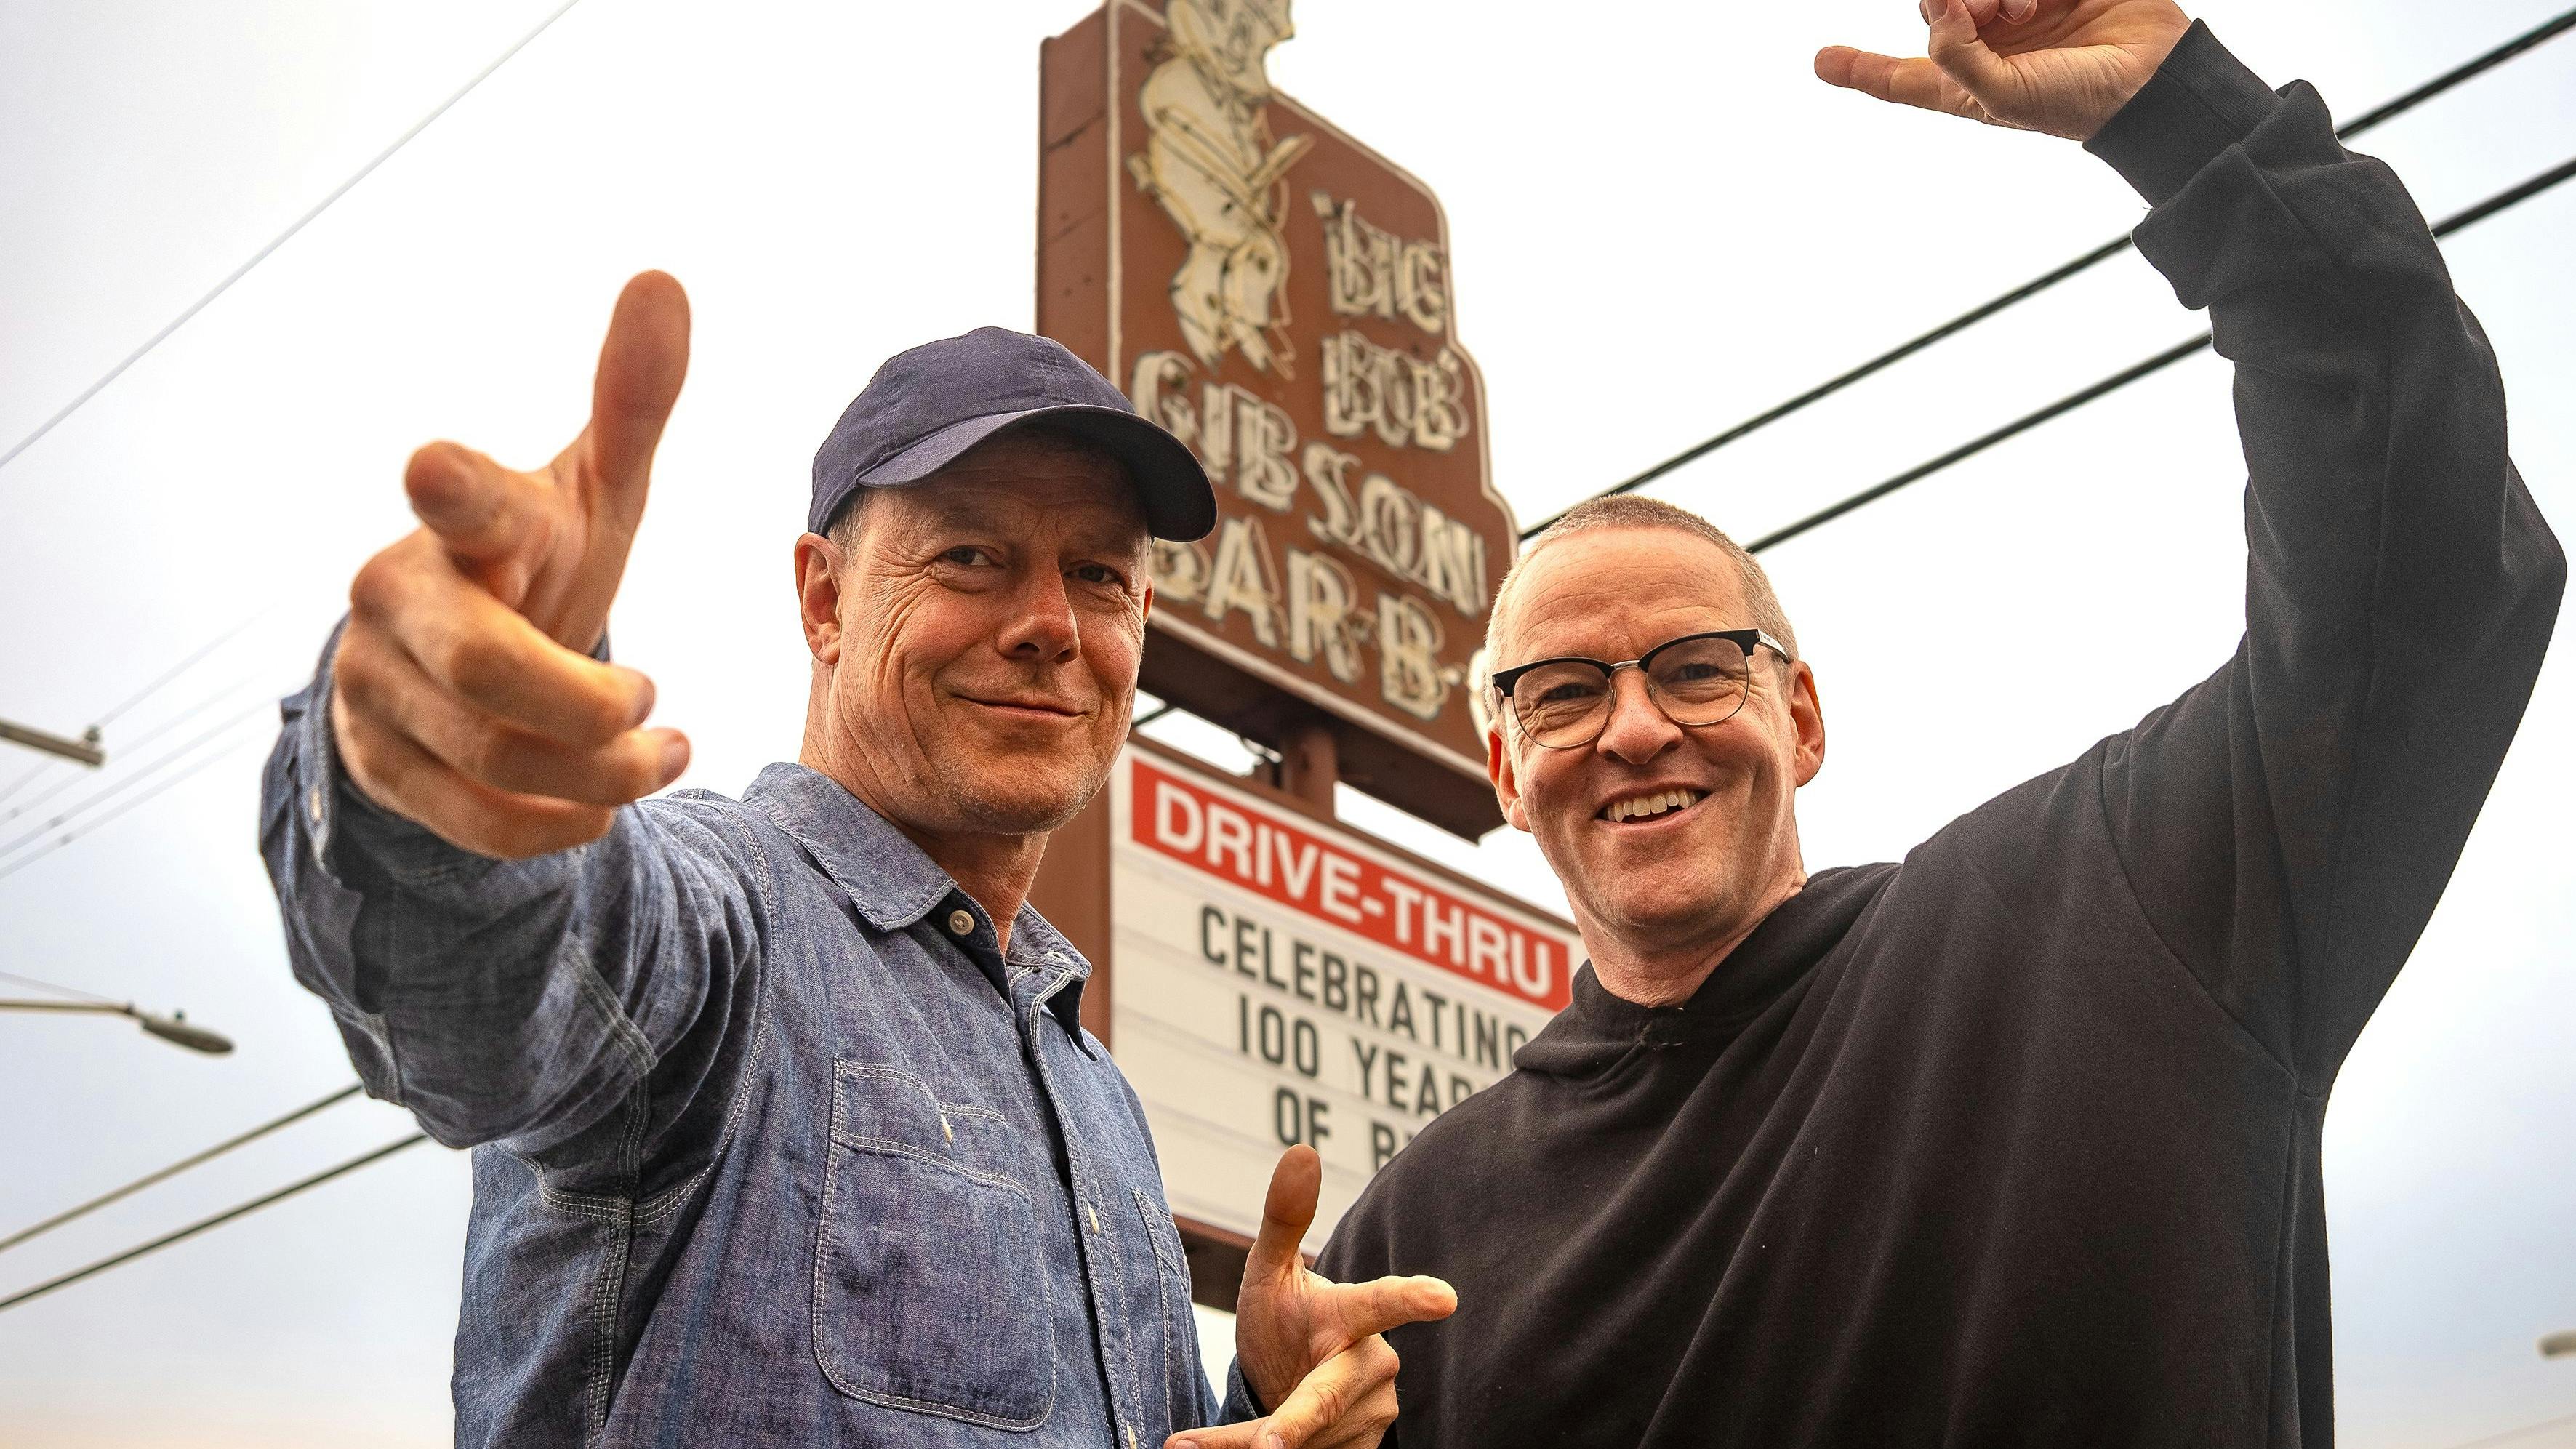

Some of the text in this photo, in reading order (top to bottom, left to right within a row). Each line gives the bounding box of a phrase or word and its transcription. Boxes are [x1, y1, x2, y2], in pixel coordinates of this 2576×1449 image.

[1132, 350, 1488, 619] GIBSON
[1155, 779, 1553, 999] DRIVE-THRU
[1239, 993, 1474, 1117] 100 YEA
[1274, 1086, 1331, 1151] OF
